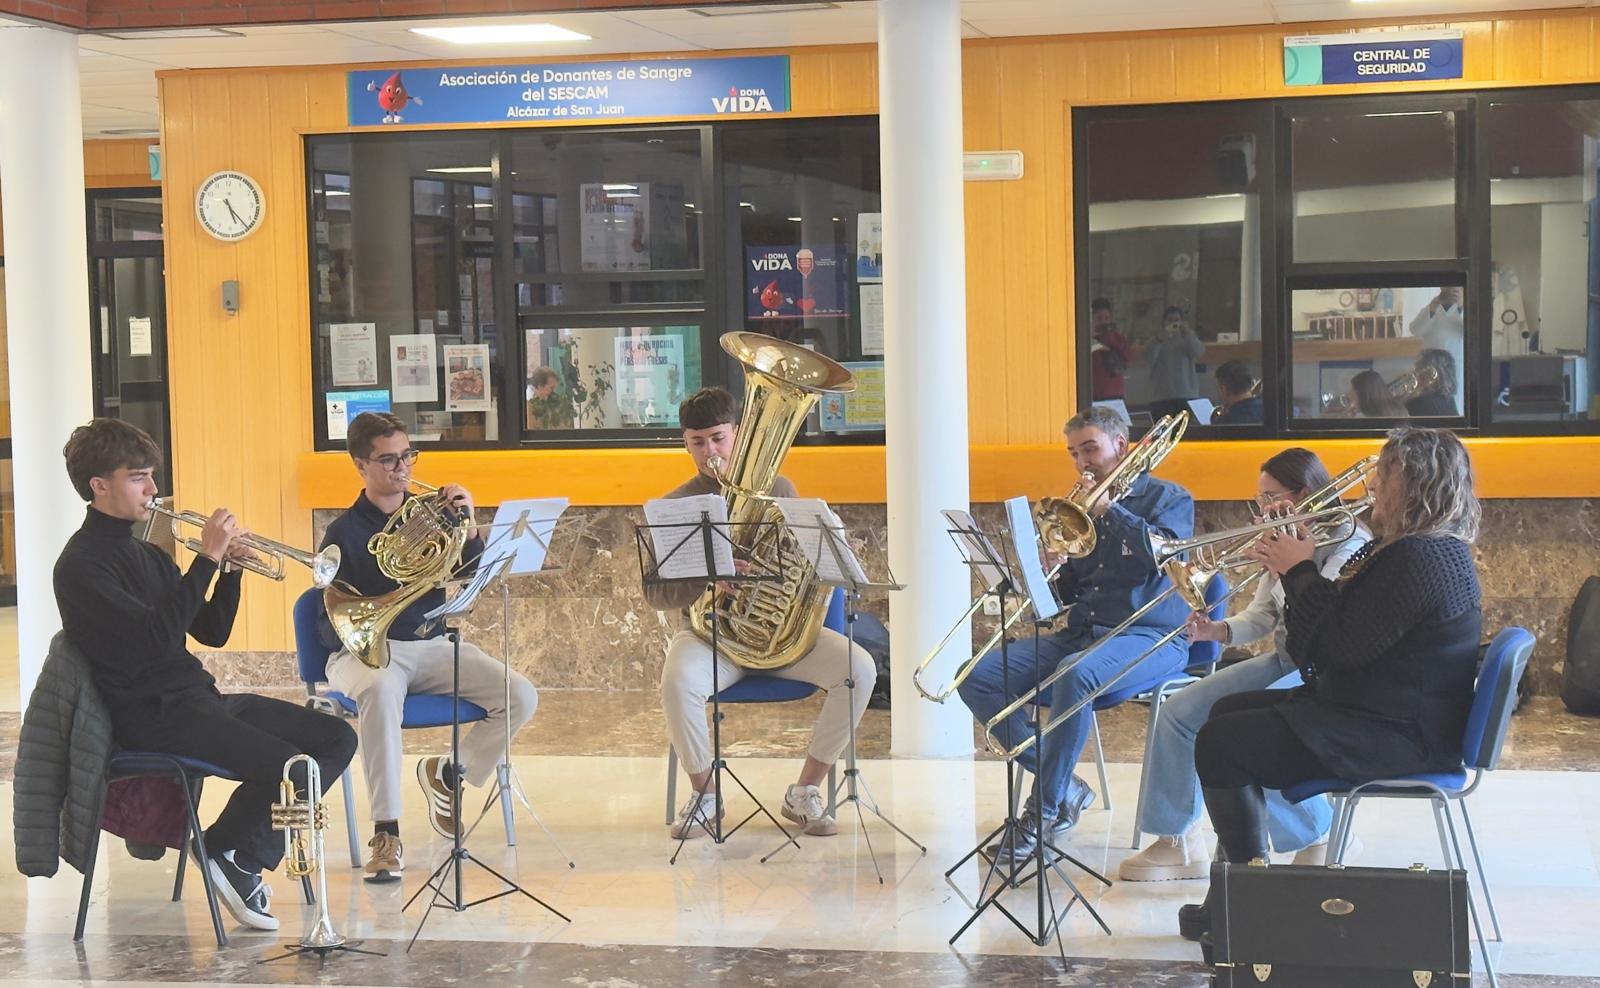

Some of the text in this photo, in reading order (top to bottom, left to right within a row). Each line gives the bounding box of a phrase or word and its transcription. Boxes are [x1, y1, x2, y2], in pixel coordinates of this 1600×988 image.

[1353, 48, 1430, 62] CENTRAL DE
[1357, 62, 1426, 76] SEGURIDAD
[439, 66, 693, 87] Asociación de Donantes de Sangre
[521, 86, 609, 102] del SESCAM
[739, 88, 766, 97] DONA
[506, 103, 625, 118] Alcázar de San Juan
[711, 96, 773, 113] VIDA
[751, 259, 793, 271] VIDA
